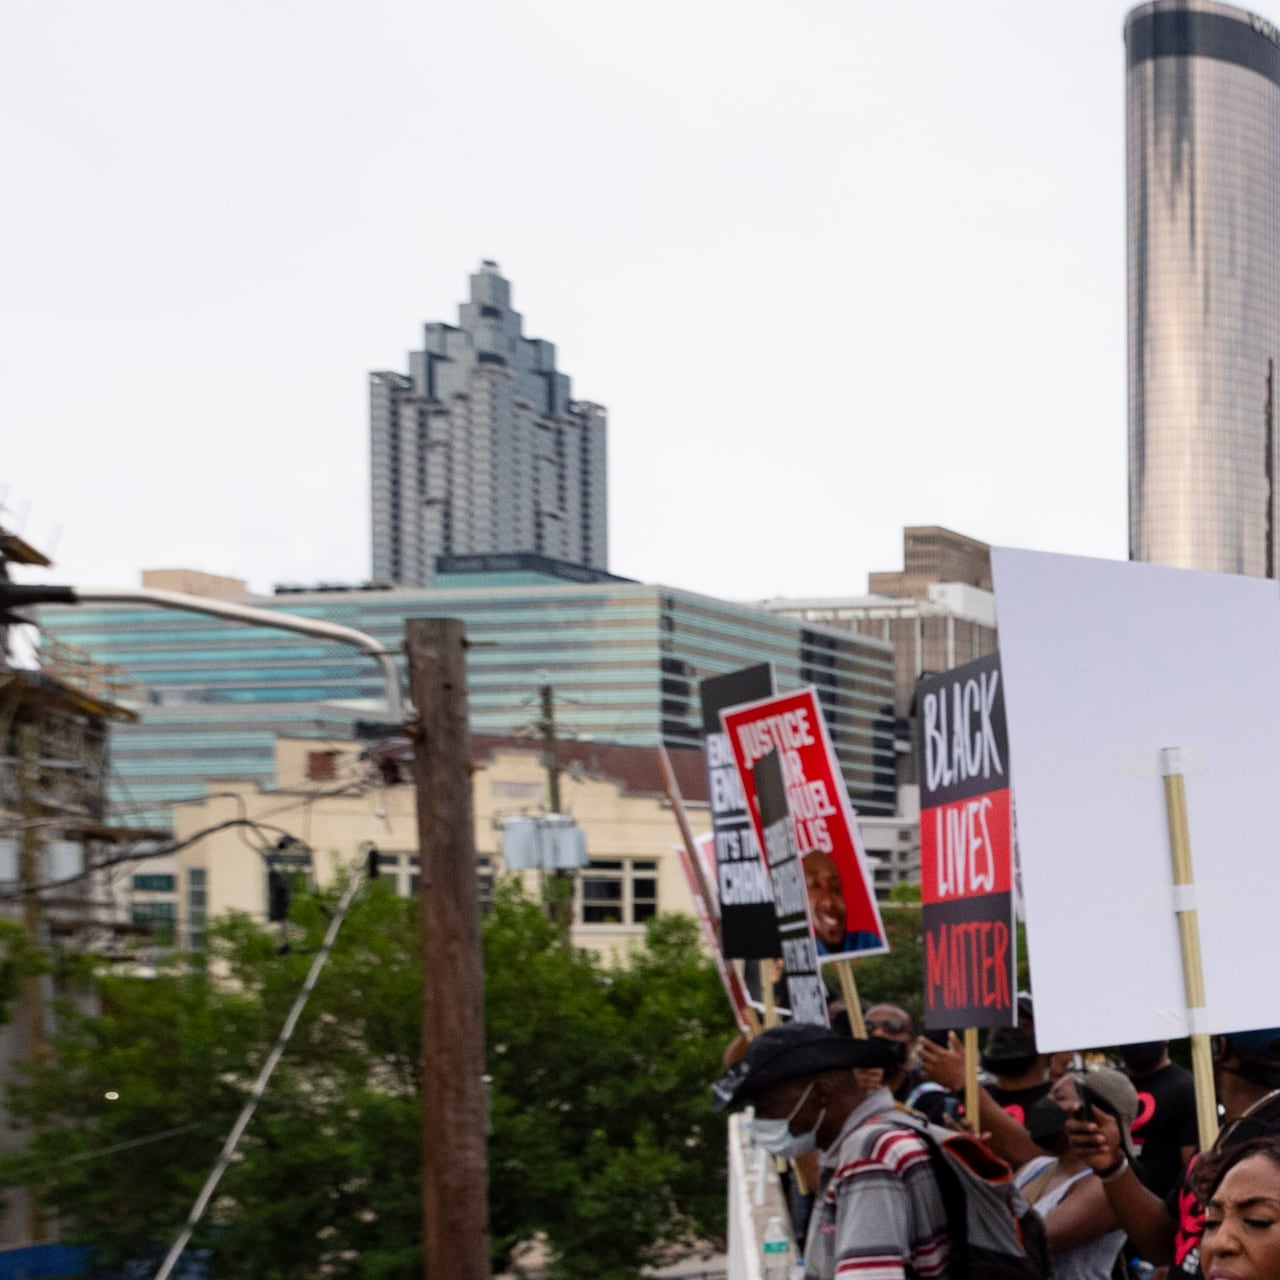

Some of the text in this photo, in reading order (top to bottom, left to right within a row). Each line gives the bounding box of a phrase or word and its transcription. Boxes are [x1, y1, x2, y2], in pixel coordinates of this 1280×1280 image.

[736, 708, 815, 769] JUSTICE
[923, 669, 1003, 792] BLACK
[936, 797, 995, 898] LIVES
[925, 920, 1012, 1012] MATTER
